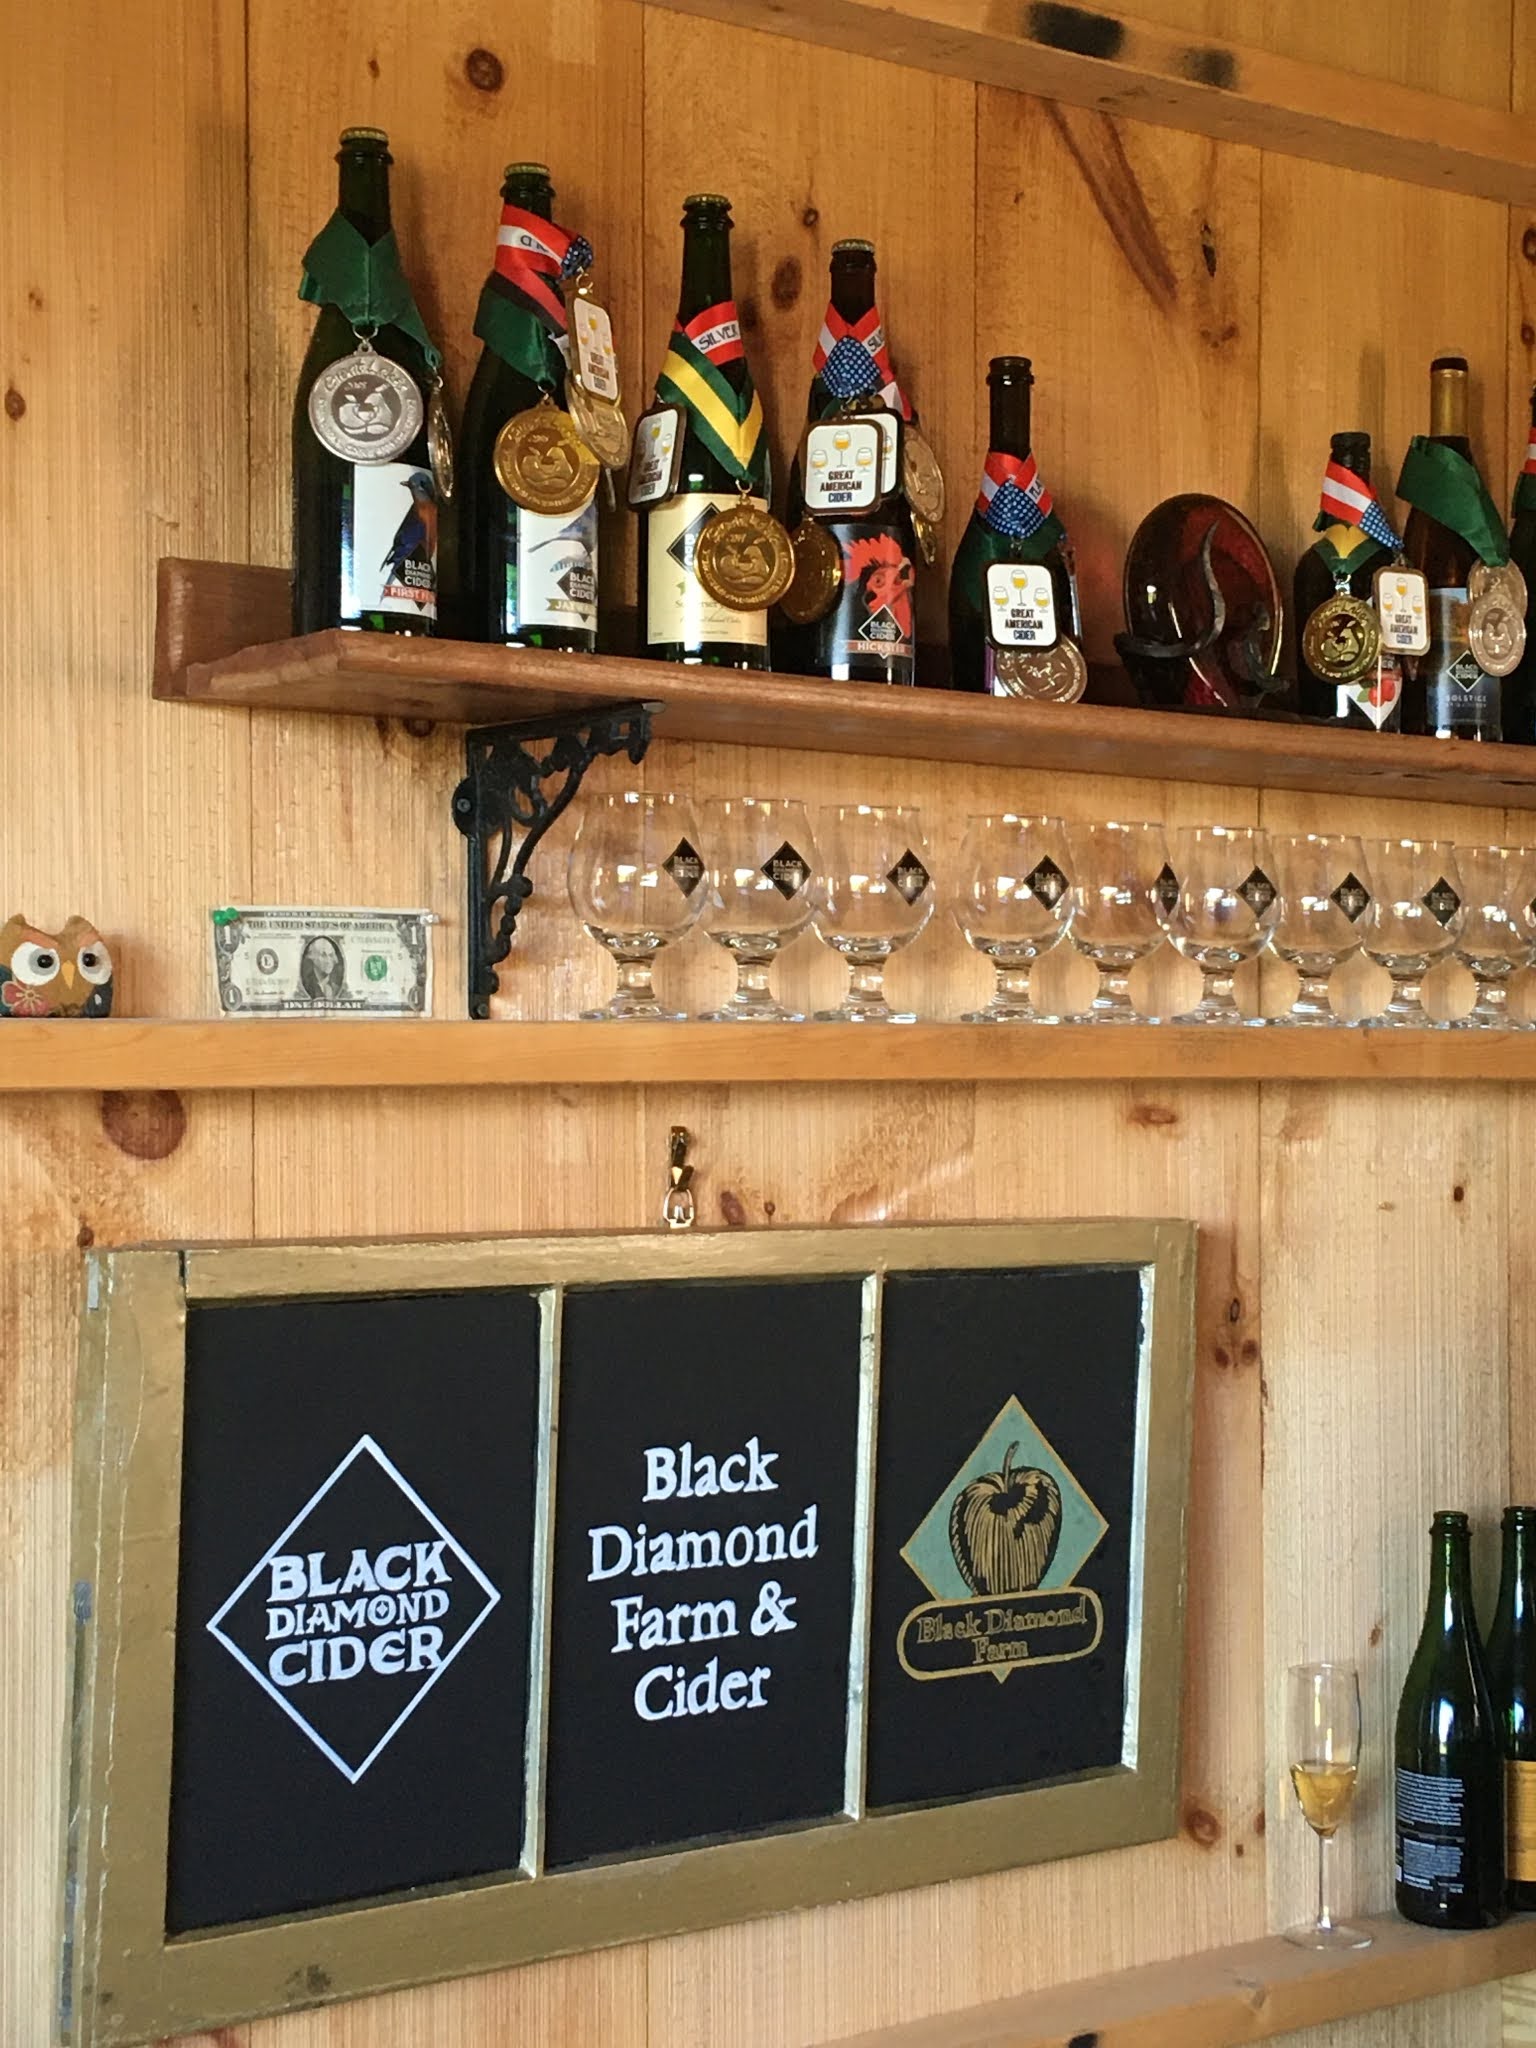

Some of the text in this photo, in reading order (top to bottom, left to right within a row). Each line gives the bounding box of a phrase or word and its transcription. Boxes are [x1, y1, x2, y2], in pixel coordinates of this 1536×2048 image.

[698, 323, 738, 350] SILVER
[828, 470, 854, 480] GREAT
[820, 481, 862, 492] AMERICAN
[828, 492, 852, 503] CIDER
[390, 587, 418, 600] FIRST
[1011, 608, 1035, 619] GREAT
[1005, 618, 1043, 630] AMERICAN
[1013, 629, 1036, 641] CIDER
[1446, 694, 1487, 703] SOLSTICE
[772, 860, 802, 869] BLACK
[223, 925, 231, 944] 1
[247, 920, 395, 932] THE UNITED STATES OF AMERICA
[410, 925, 418, 945] 1
[229, 988, 235, 1003] 1
[283, 1001, 362, 1009] ONE DOLLAR
[642, 1436, 779, 1502] Black
[587, 1504, 819, 1582] Diamond
[265, 1540, 453, 1603] BLACK
[265, 1588, 450, 1640] DIAMOND
[610, 1580, 797, 1653] Farm &
[917, 1596, 1088, 1643] Black Diamond
[268, 1625, 445, 1686] CIDER
[972, 1637, 1029, 1665] Farm
[634, 1656, 771, 1721] Cider
